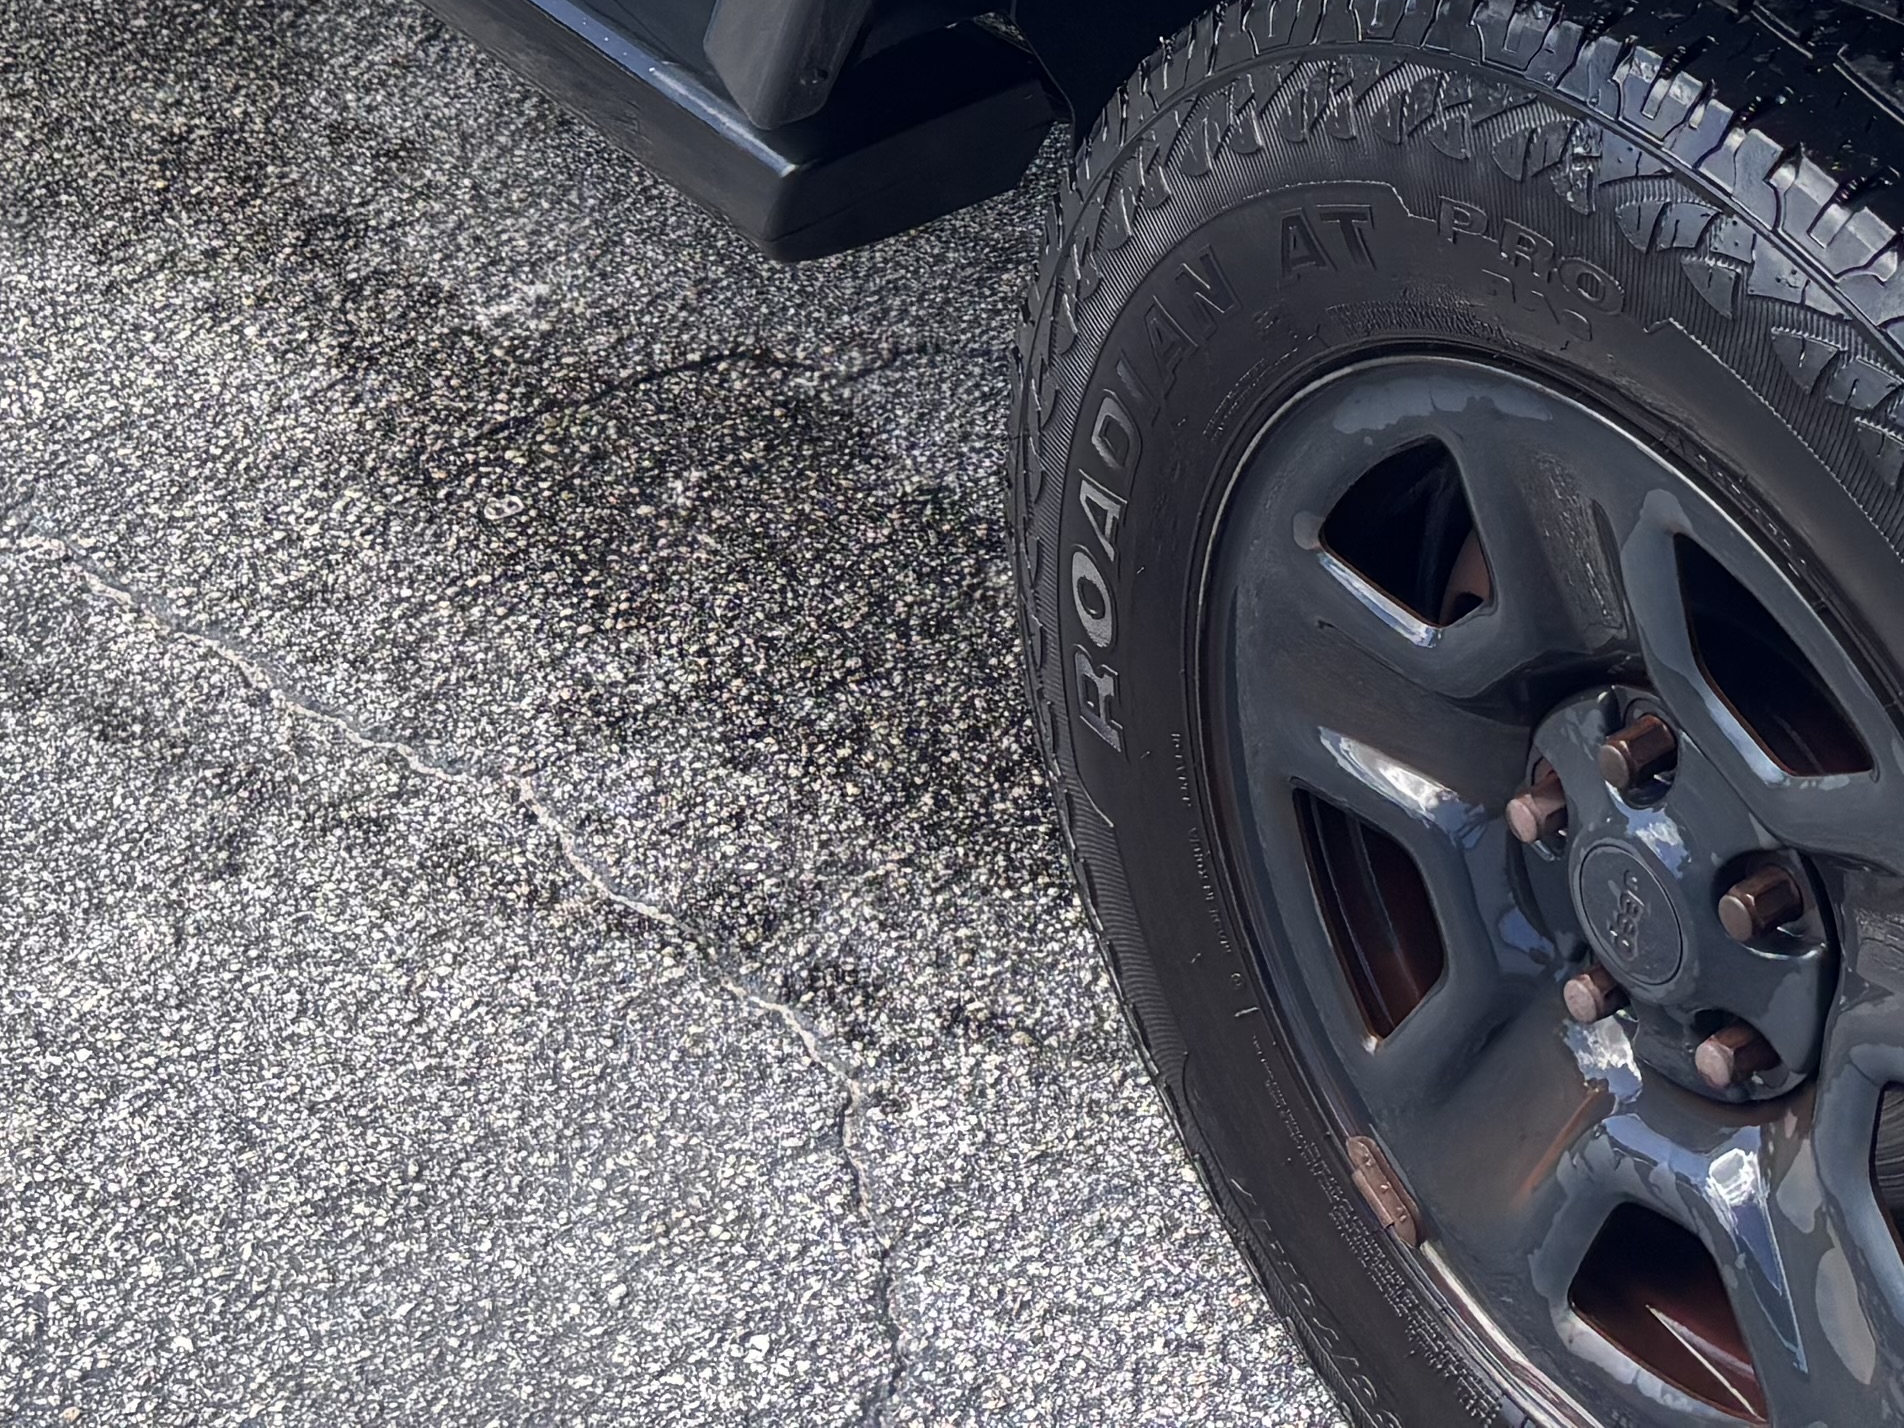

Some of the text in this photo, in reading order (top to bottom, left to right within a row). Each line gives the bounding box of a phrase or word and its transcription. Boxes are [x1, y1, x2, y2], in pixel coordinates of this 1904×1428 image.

[1071, 245, 1244, 752] ROADIAN
[1280, 202, 1377, 277] AT
[1437, 195, 1625, 315] PRO
